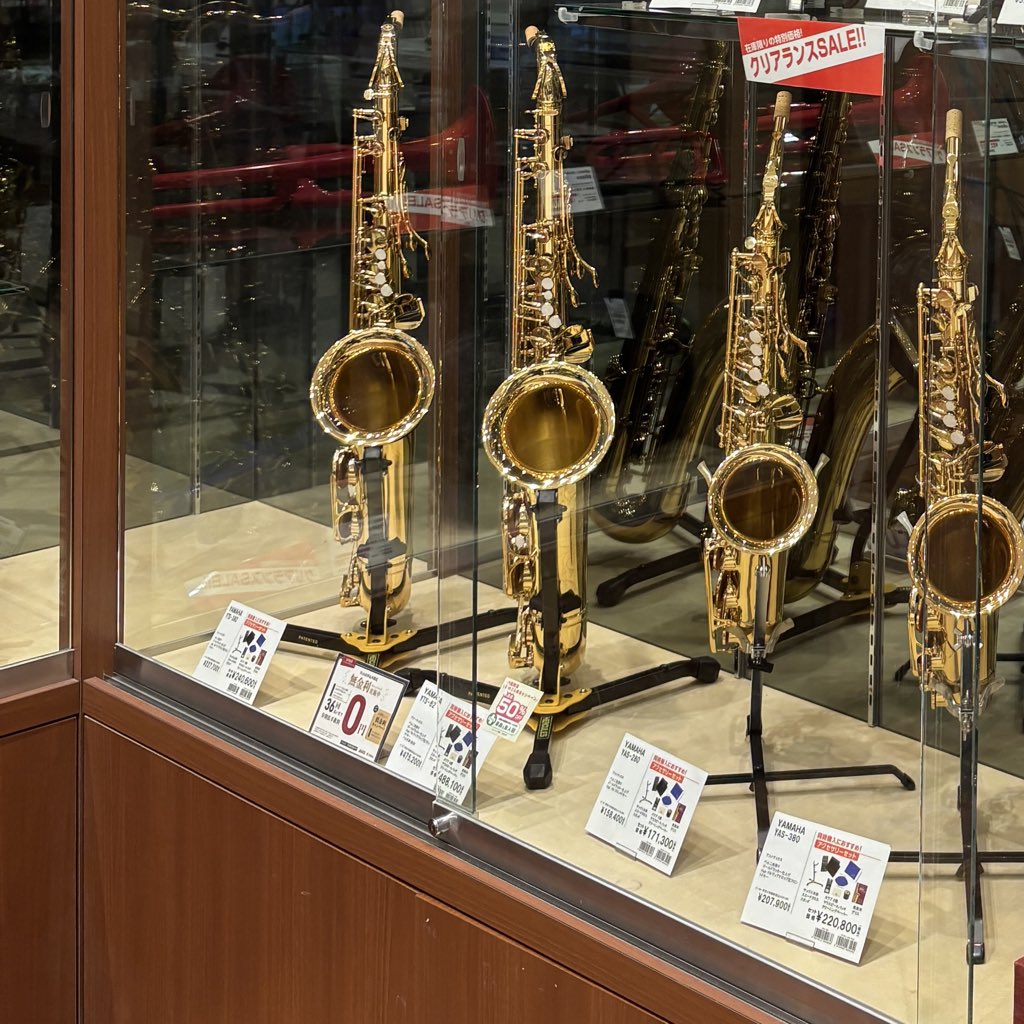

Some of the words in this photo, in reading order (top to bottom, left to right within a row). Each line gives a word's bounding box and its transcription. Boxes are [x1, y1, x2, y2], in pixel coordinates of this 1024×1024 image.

[750, 27, 867, 78] クリアランスSALE!!
[342, 695, 366, 735] 0
[621, 749, 640, 764] YAS-280
[625, 740, 646, 757] YAMAHA
[438, 771, 463, 793] 488,100
[774, 828, 800, 843] YAS-380
[778, 819, 806, 835] YAMAHA
[643, 826, 674, 850] ¥171,300
[816, 841, 857, 859] アクセサリーセット
[758, 893, 788, 910] ¥207,900
[816, 911, 858, 934] ¥220,800
